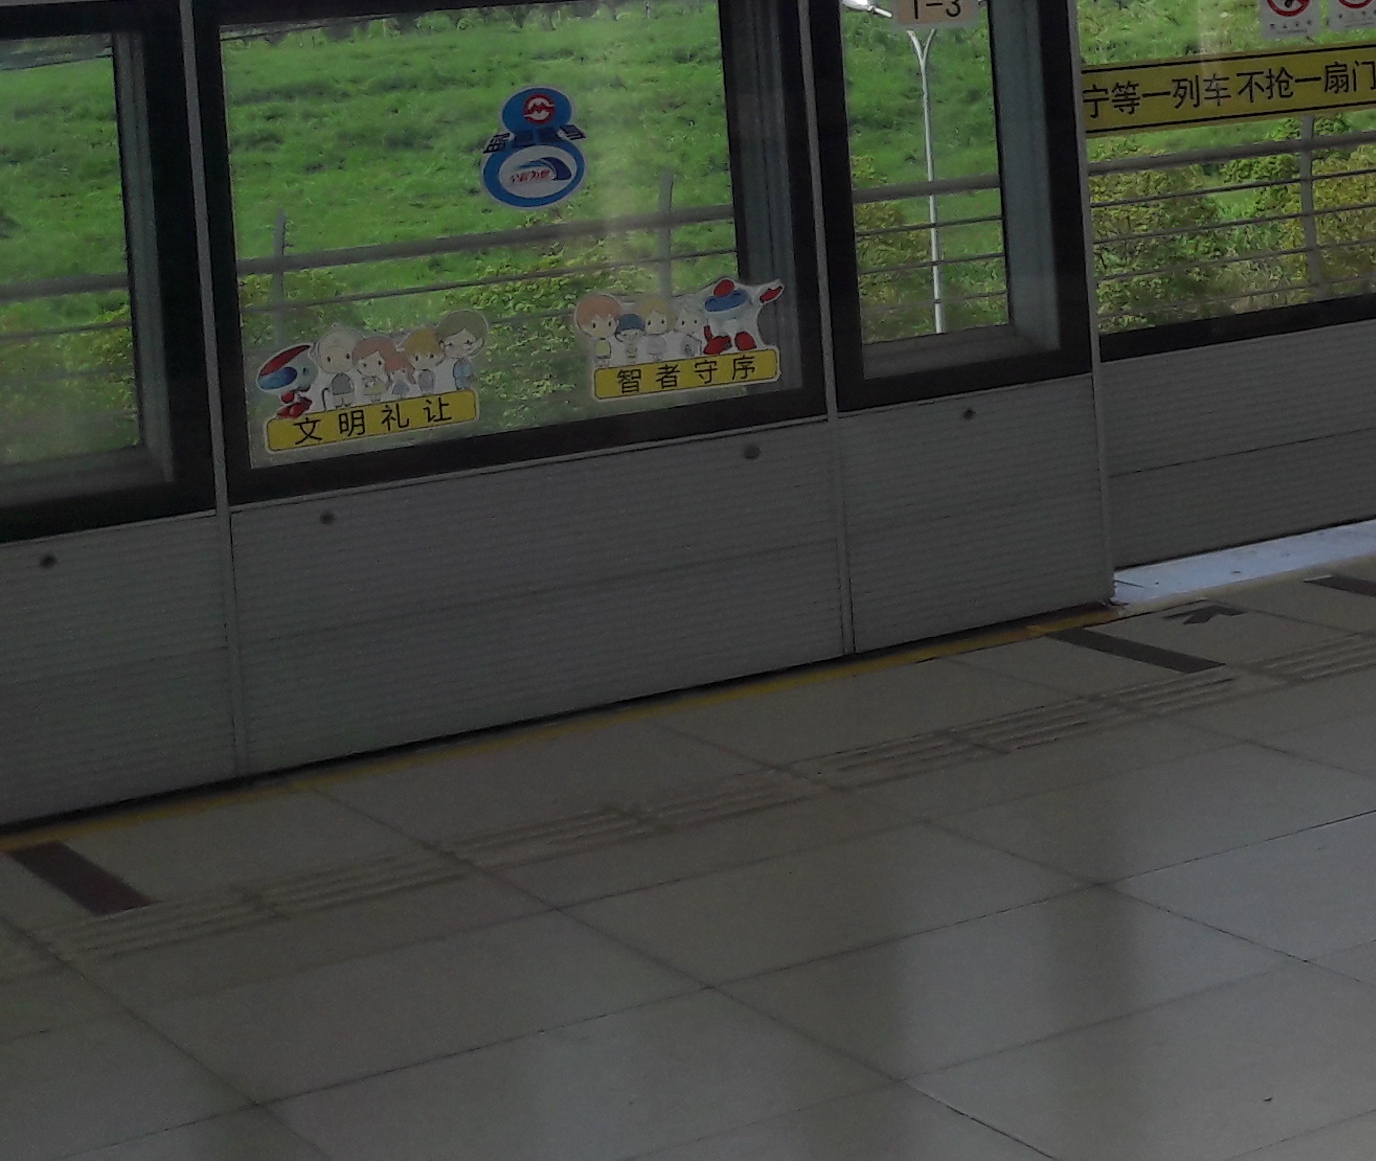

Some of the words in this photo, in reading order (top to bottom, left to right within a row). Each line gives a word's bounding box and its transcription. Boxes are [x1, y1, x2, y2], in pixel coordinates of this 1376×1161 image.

[617, 355, 755, 394] 智者守序
[293, 396, 452, 445] 文明礼让
